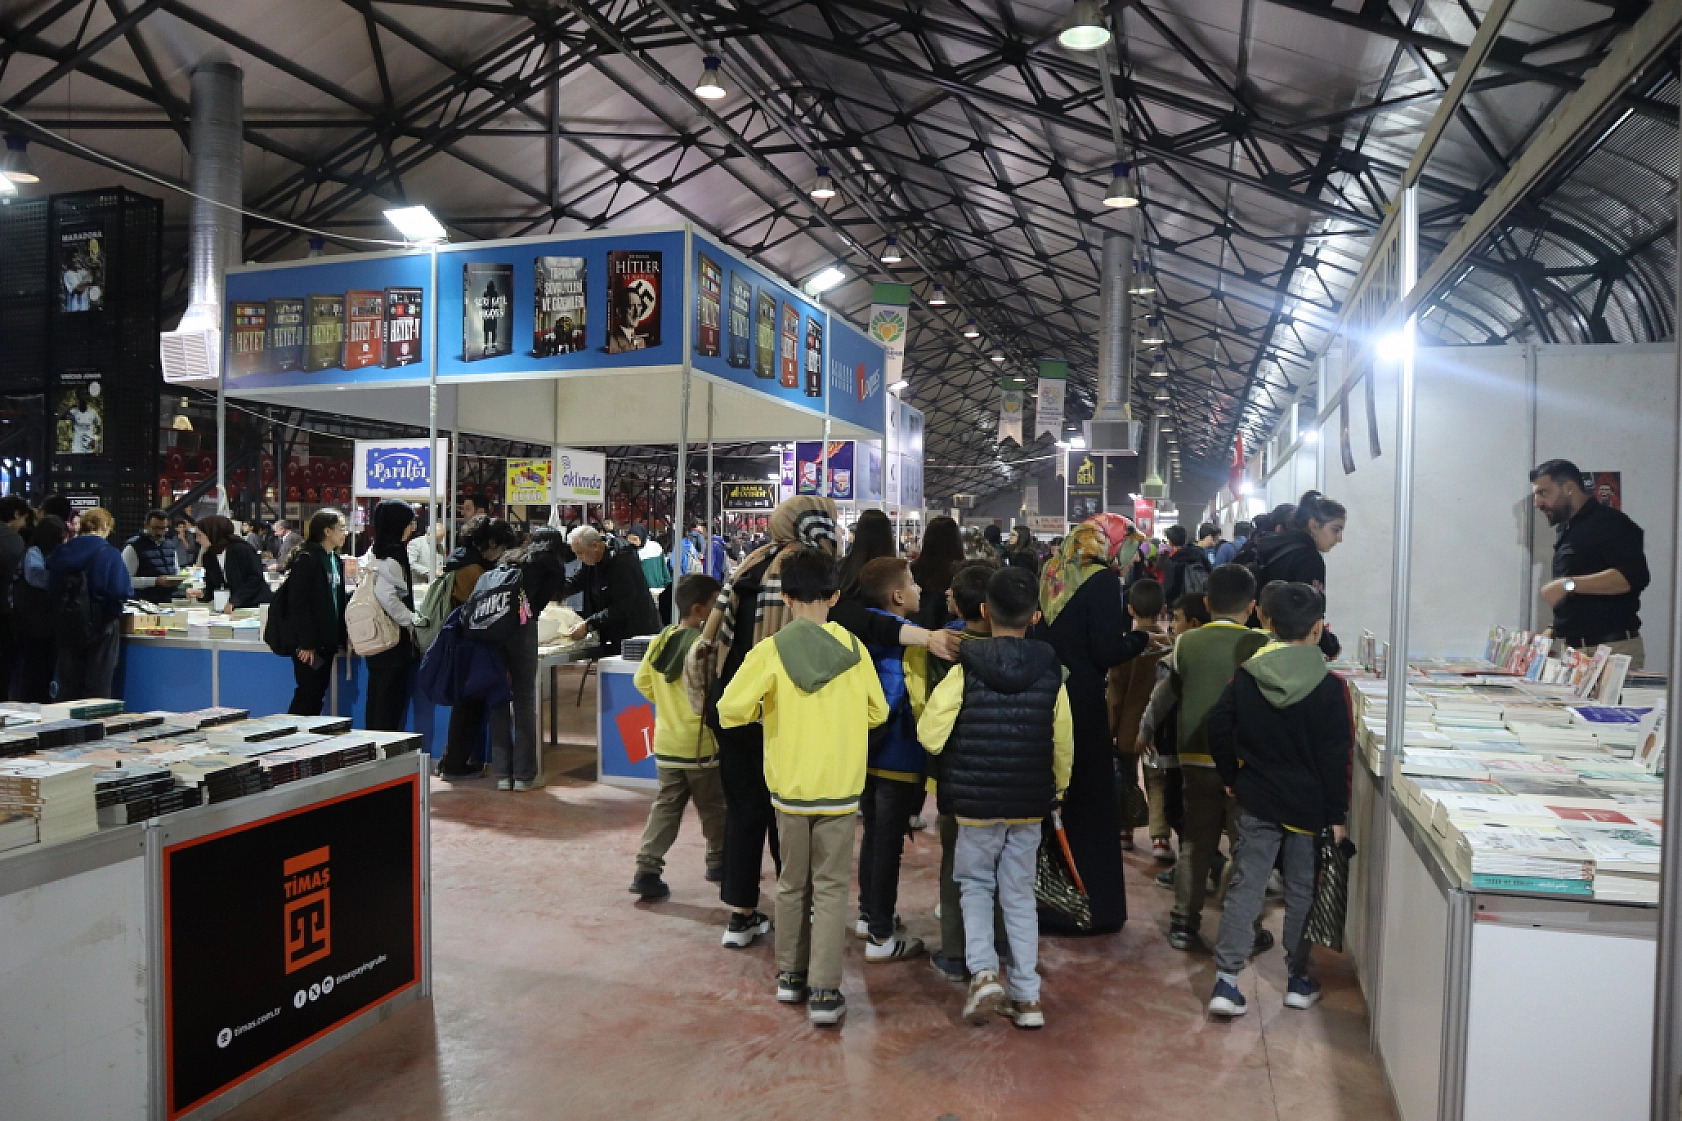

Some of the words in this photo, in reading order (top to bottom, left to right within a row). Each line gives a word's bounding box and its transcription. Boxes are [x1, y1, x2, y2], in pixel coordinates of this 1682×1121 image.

[615, 258, 660, 274] HİTLER
[474, 590, 511, 619] NIKE
[283, 867, 331, 899] TİMAŞ
